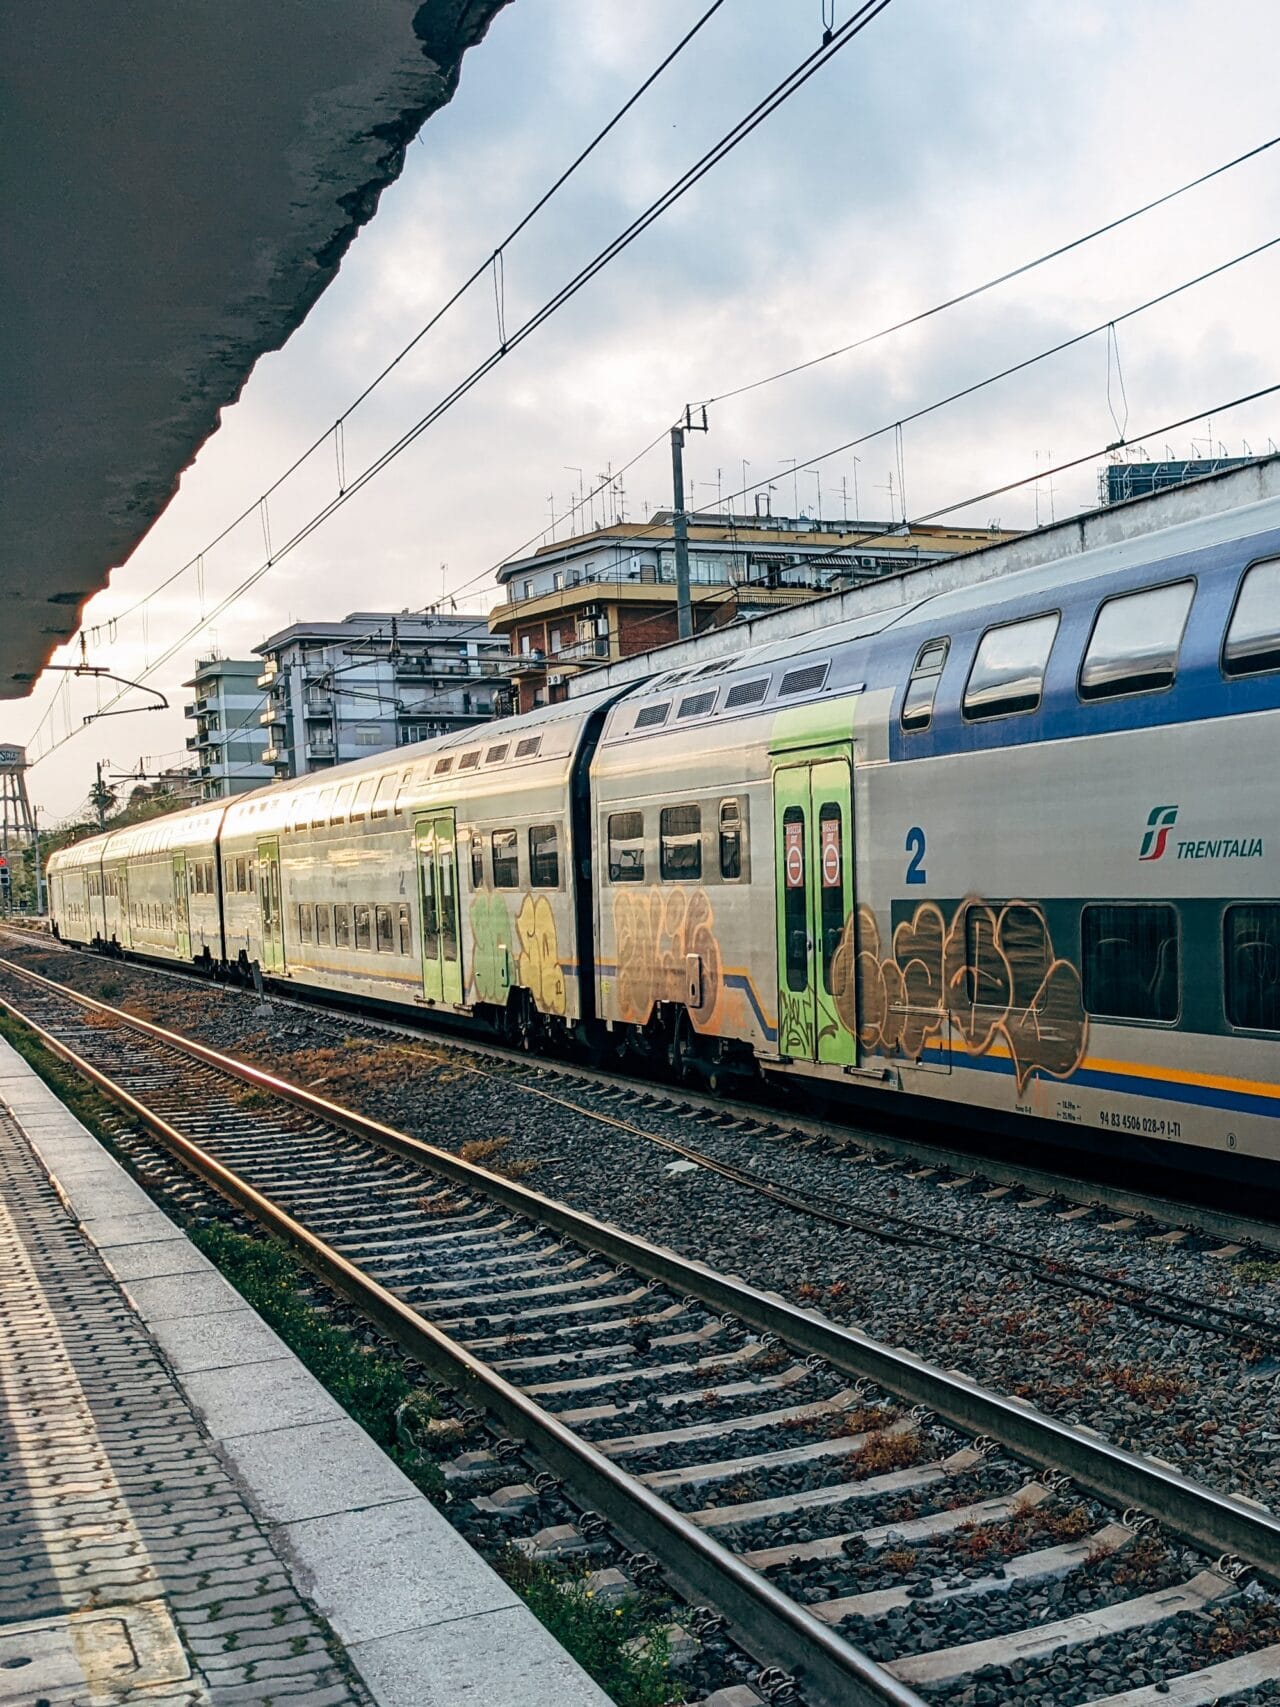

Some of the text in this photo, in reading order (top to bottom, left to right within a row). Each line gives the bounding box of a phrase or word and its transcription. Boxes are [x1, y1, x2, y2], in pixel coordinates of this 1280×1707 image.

[905, 826, 927, 884] 2
[1177, 838, 1263, 860] TRENITALIA
[1099, 1111, 1109, 1126] 94
[1111, 1113, 1121, 1127] 83
[1122, 1115, 1141, 1131] 4506
[1142, 1117, 1166, 1134] 028-9
